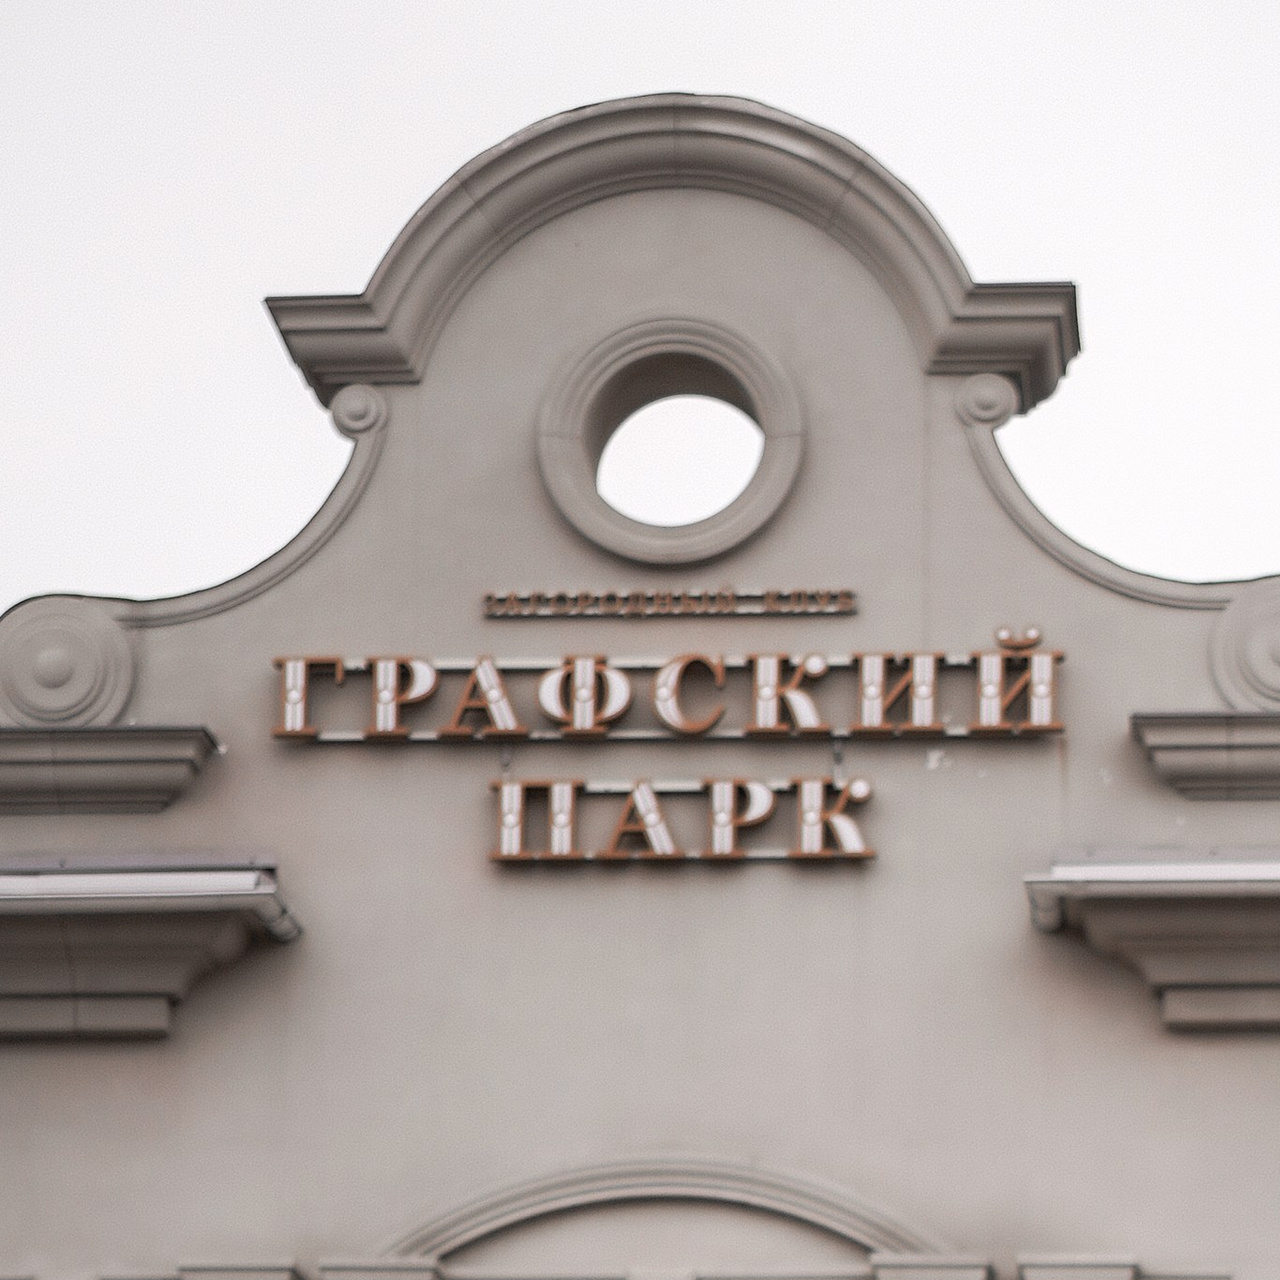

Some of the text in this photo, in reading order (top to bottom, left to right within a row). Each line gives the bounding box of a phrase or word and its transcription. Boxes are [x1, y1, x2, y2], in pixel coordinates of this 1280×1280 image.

[764, 589, 857, 614] КЛУБ
[273, 626, 1064, 738] ГРАФСКИЙ
[490, 776, 876, 862] ПАРК
